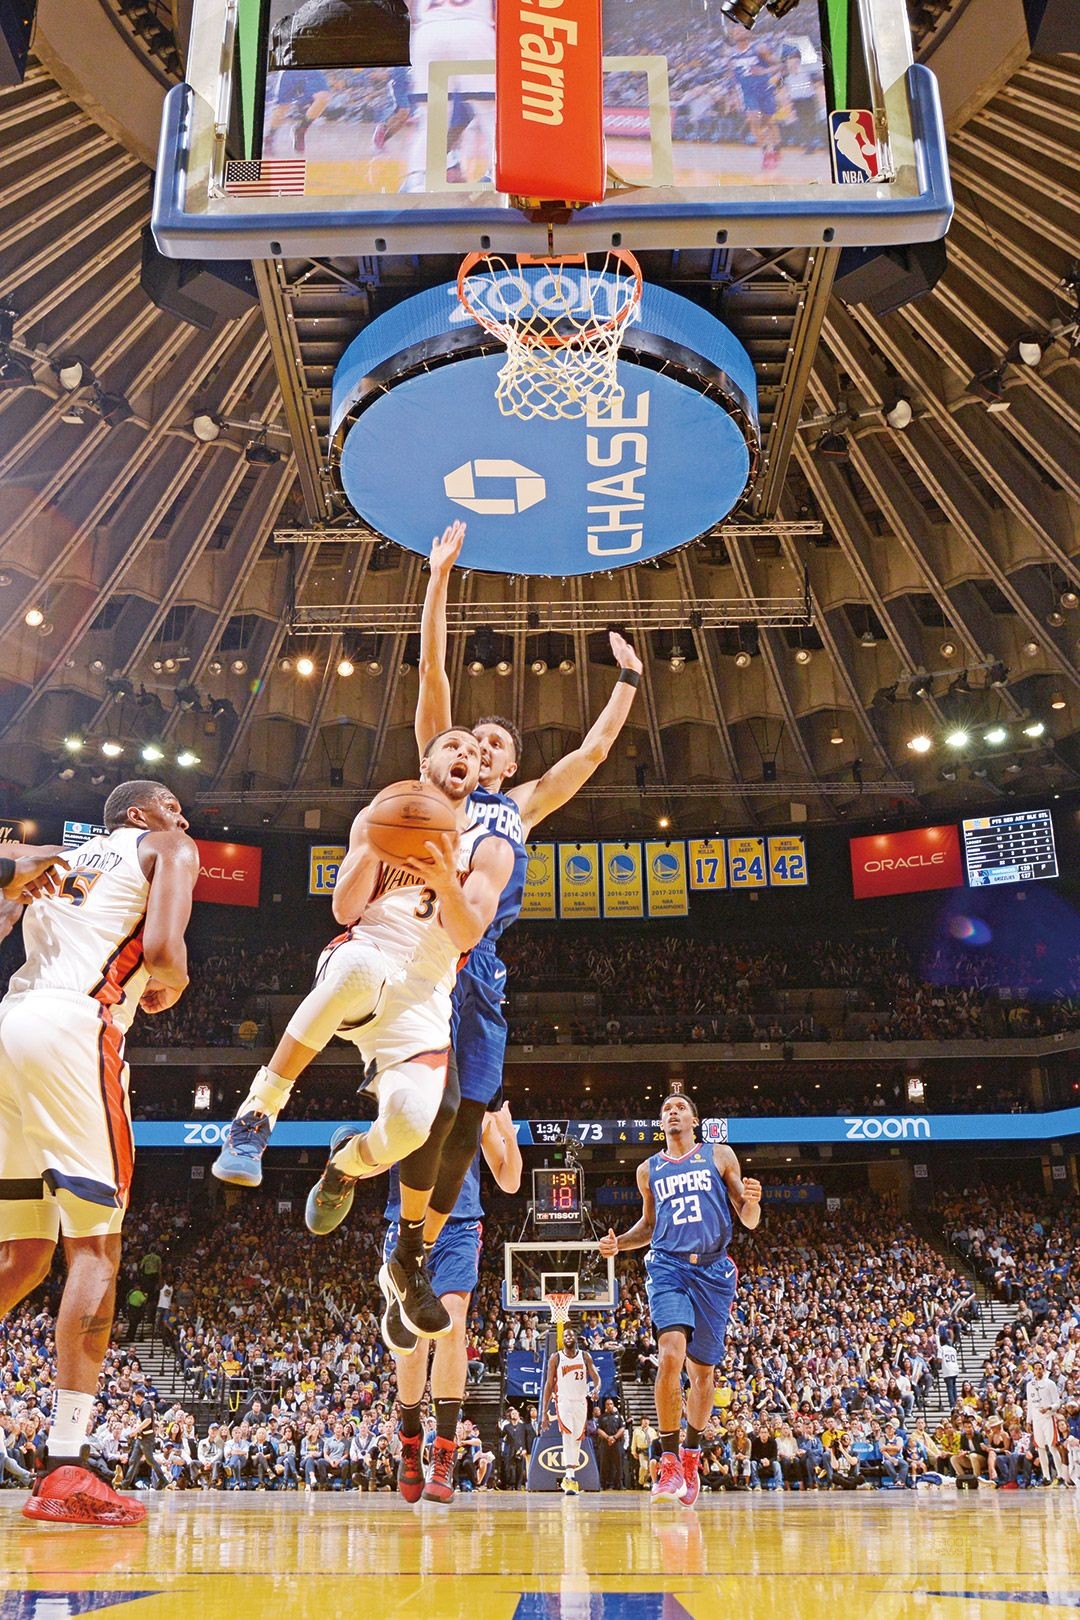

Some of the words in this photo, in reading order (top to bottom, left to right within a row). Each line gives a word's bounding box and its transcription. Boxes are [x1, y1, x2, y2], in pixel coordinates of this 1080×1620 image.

[842, 171, 864, 183] NBA
[586, 390, 650, 557] CHASE
[696, 858, 718, 883] 17
[732, 856, 764, 881] 24
[774, 855, 804, 879] 42
[864, 852, 944, 872] ORACLE
[316, 864, 340, 888] 13
[59, 871, 102, 908] 5
[414, 888, 438, 921] 3
[537, 1124, 561, 1134] 1:34
[578, 1124, 603, 1140] 73
[620, 1132, 626, 1141] 4
[639, 1132, 645, 1140] 3
[653, 1132, 665, 1140] 26
[844, 1118, 930, 1138] zoom
[552, 1174, 575, 1185] 1:34
[654, 1169, 712, 1201] CLIPPERS
[553, 1187, 572, 1208] 18
[671, 1195, 702, 1225] 23
[574, 1372, 584, 1380] 23
[547, 1452, 580, 1467] KI
